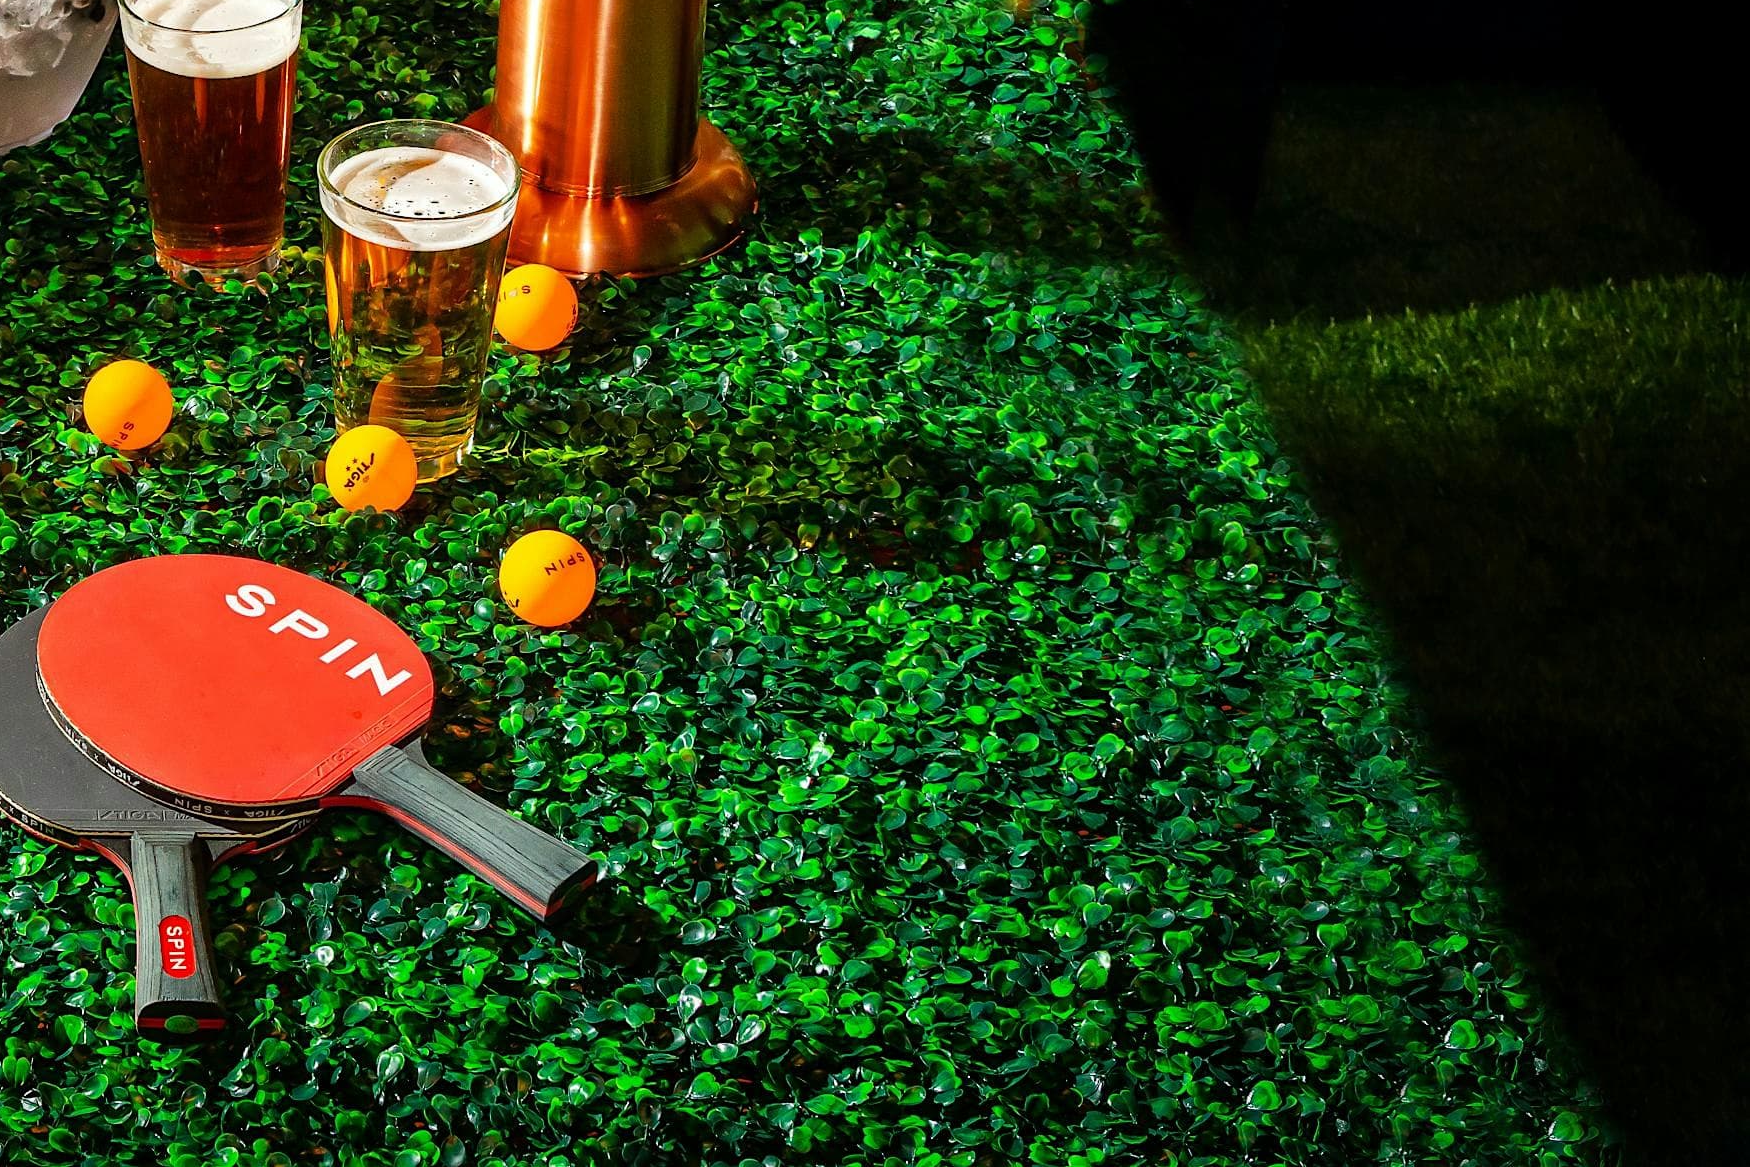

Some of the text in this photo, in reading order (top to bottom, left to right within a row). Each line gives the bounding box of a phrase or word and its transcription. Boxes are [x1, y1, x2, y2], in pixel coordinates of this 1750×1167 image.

[544, 552, 586, 576] SPIN
[225, 584, 413, 697] SPIN
[174, 798, 212, 814] SPIN
[166, 925, 187, 971] SPIN
